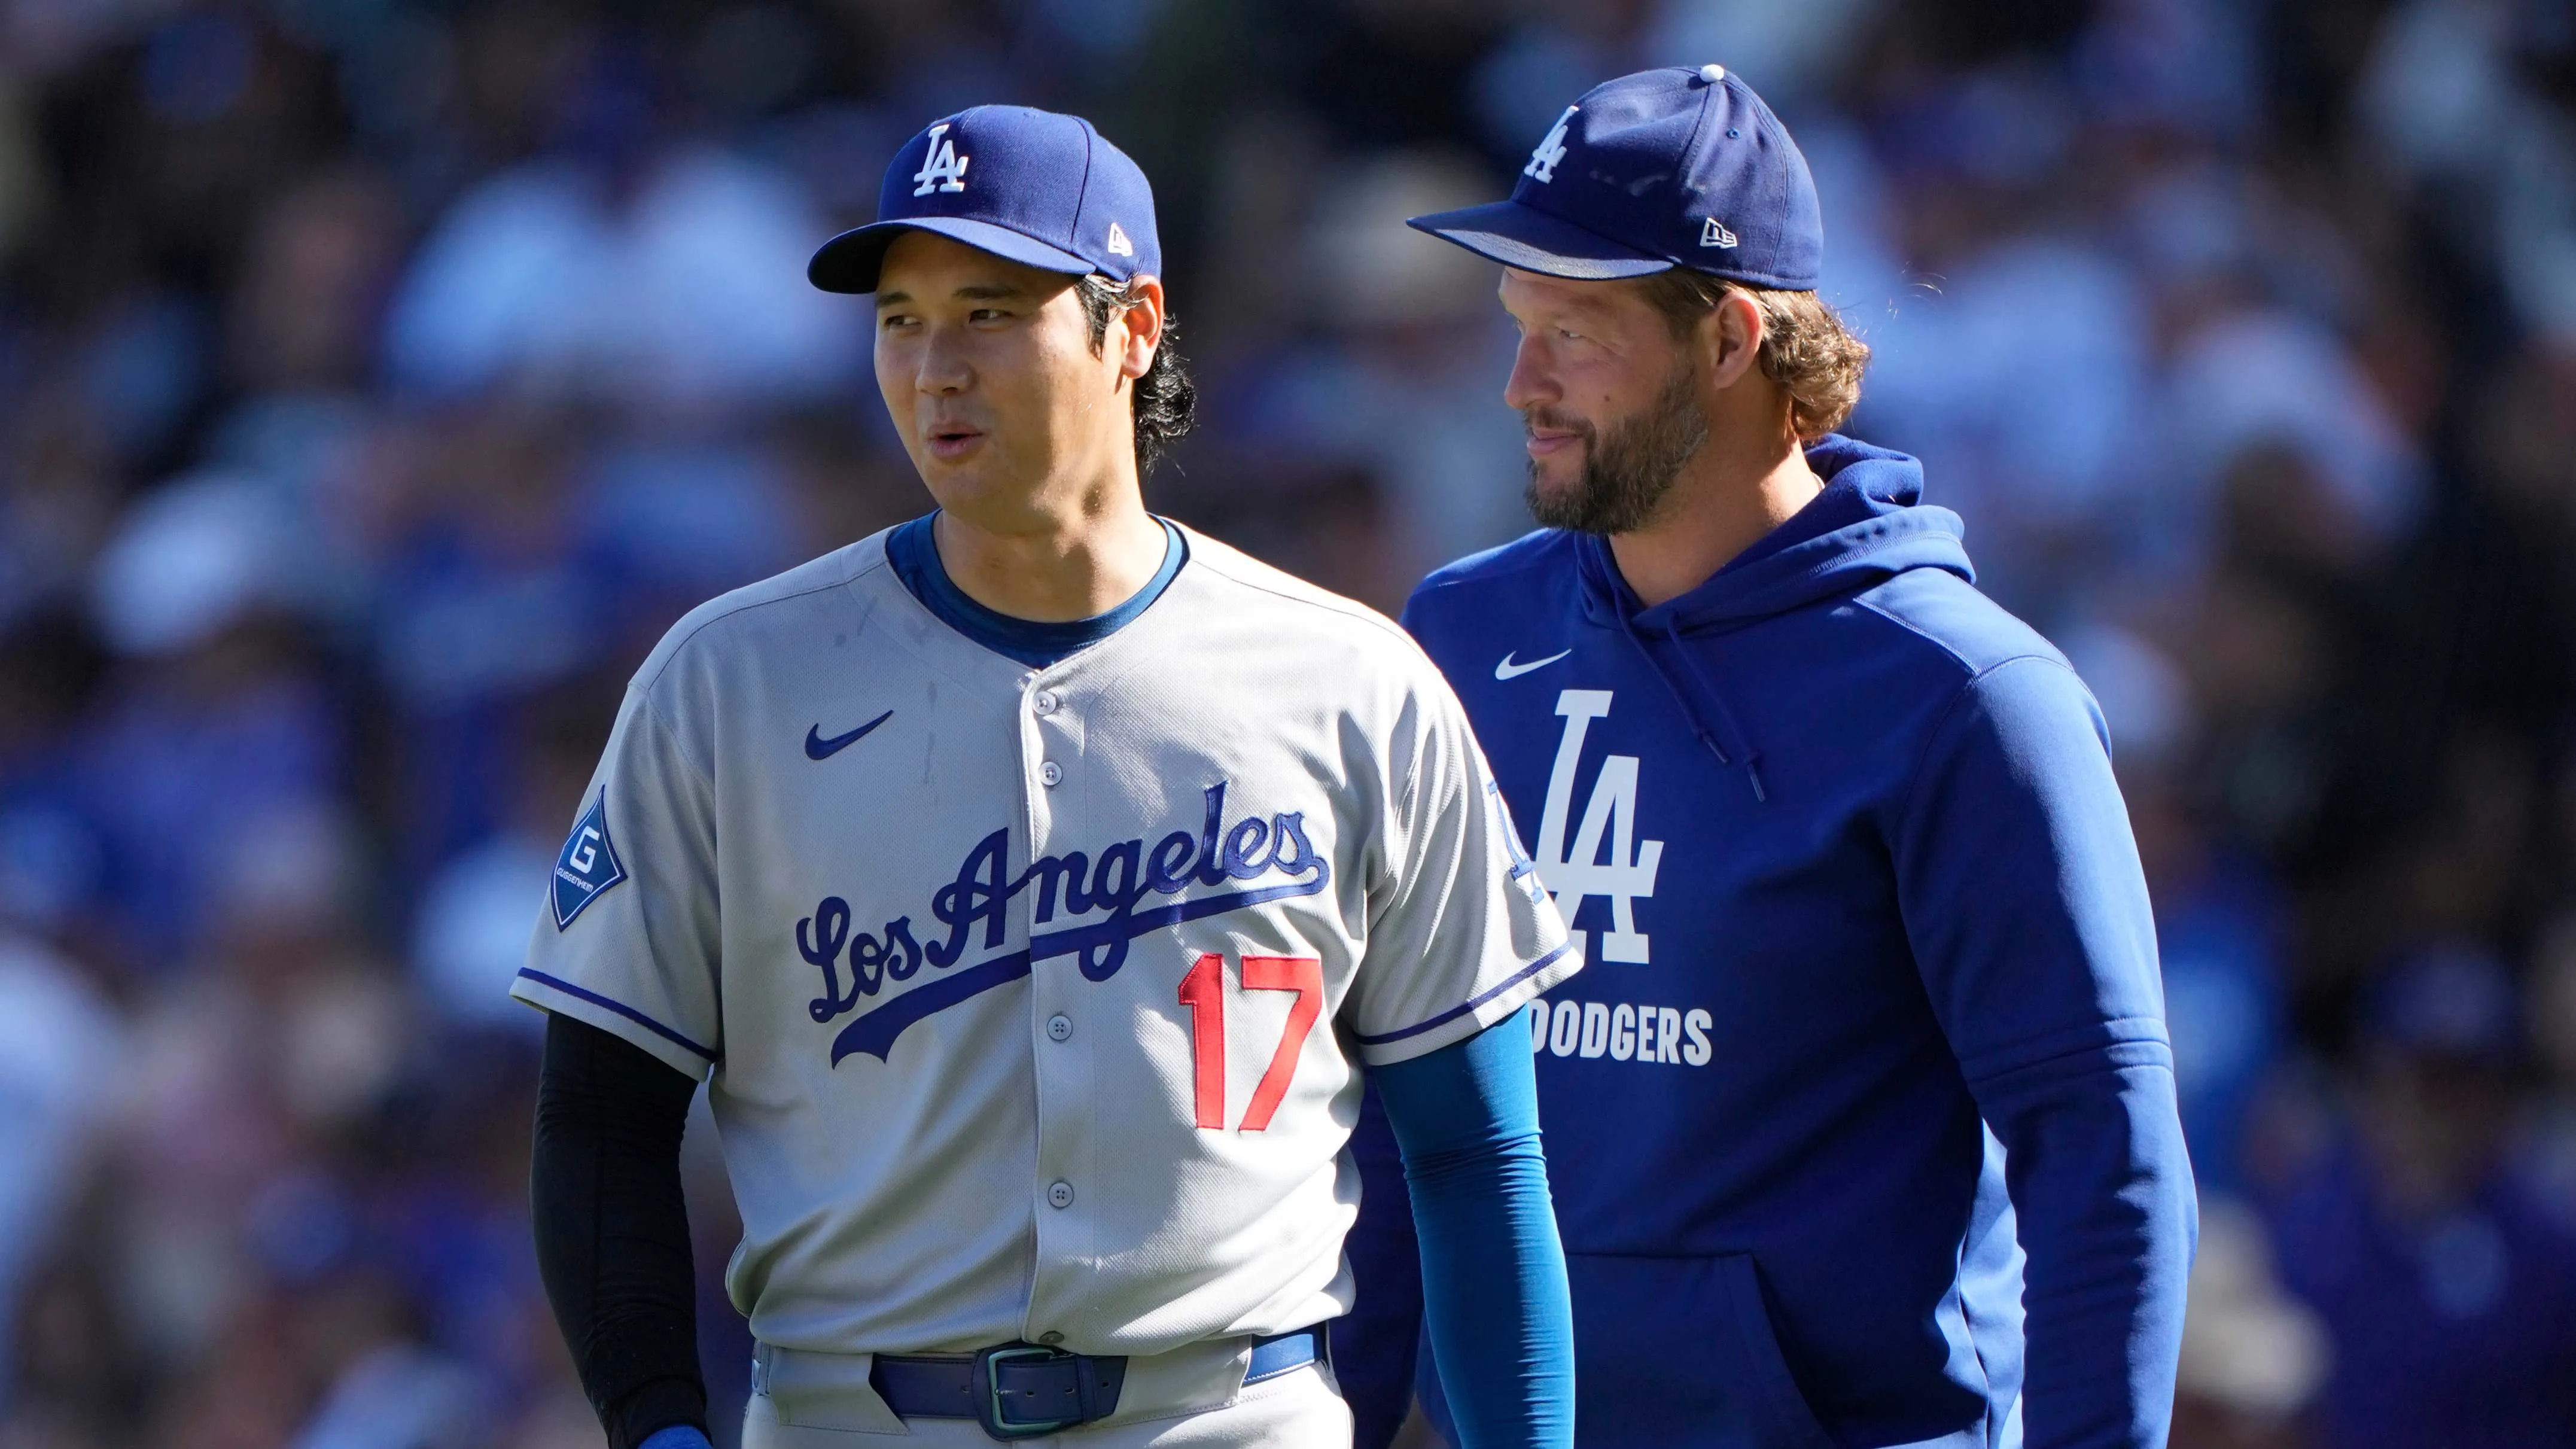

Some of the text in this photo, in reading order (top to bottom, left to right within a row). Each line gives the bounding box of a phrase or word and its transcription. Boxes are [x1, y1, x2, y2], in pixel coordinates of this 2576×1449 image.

[914, 124, 969, 197] LA
[1524, 105, 1579, 184] LA
[570, 826, 600, 874] G
[1531, 689, 1664, 964] LA
[556, 867, 593, 893] GUGGENHEIM
[796, 896, 922, 1023] Los
[925, 780, 1329, 982] Angeles
[1178, 953, 1323, 1131] 17
